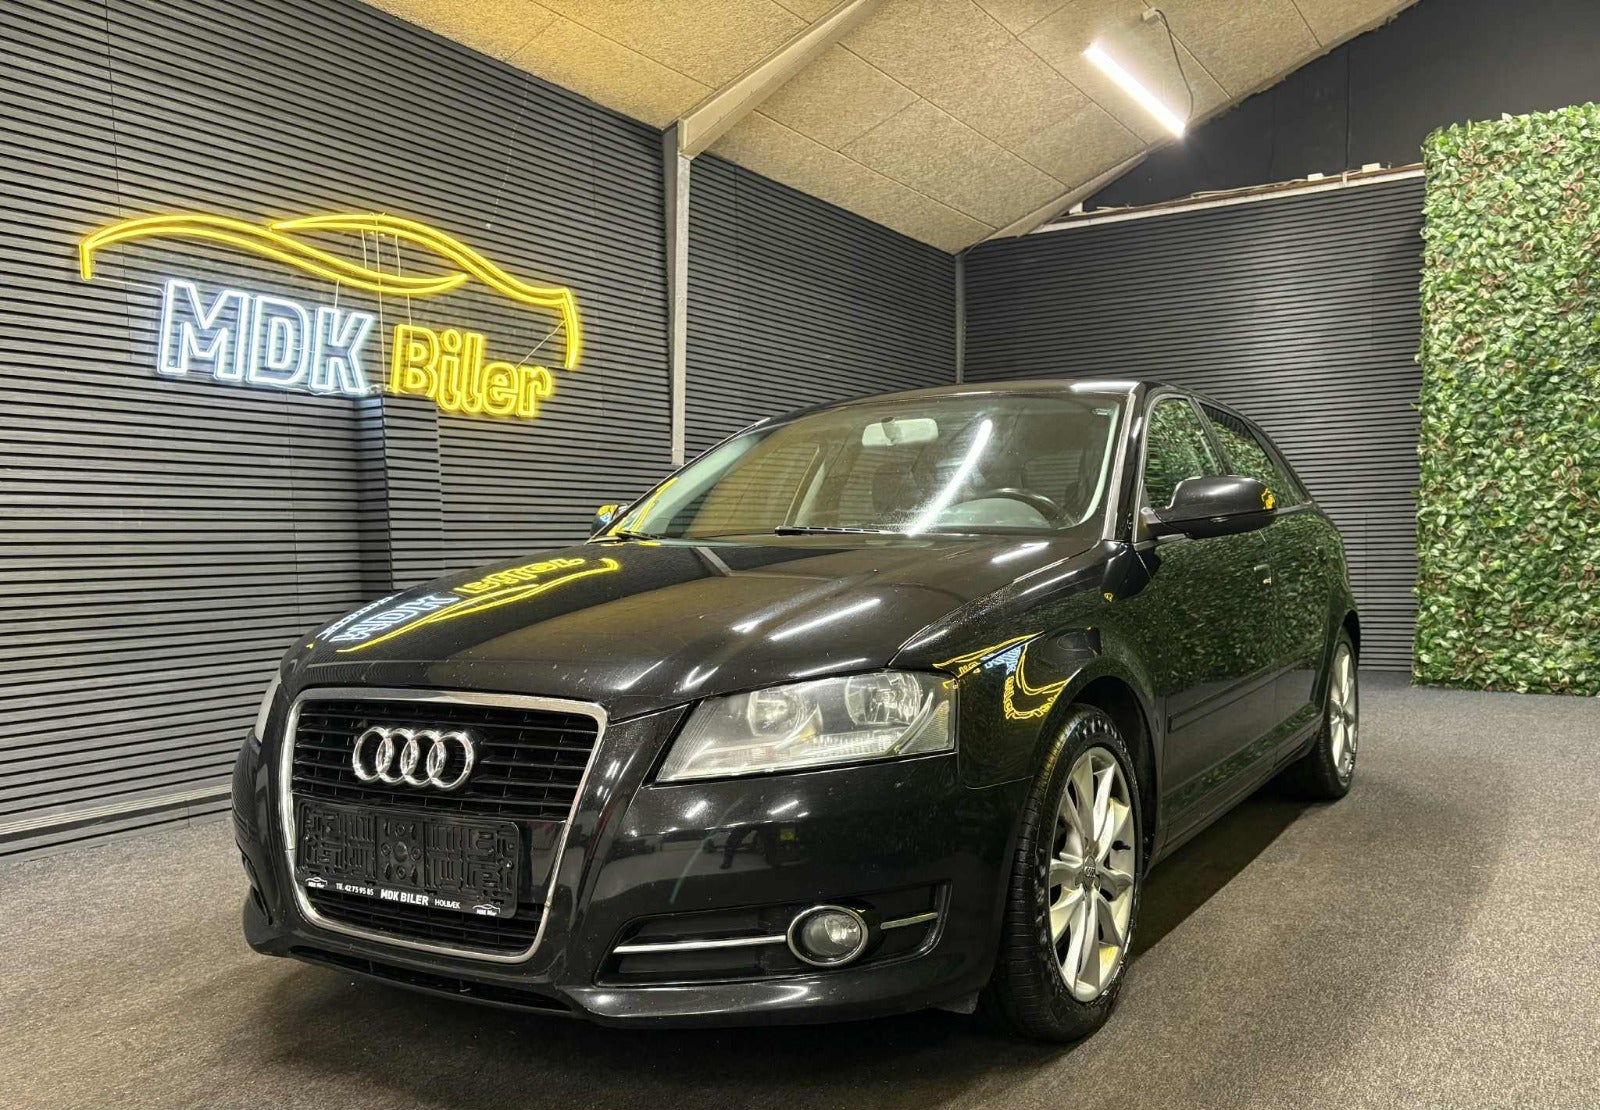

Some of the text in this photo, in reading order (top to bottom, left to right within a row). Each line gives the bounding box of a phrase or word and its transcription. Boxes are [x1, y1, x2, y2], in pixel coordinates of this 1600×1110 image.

[157, 279, 554, 418] MDK Biler
[380, 888, 399, 901] MDK
[400, 891, 429, 906] BILER
